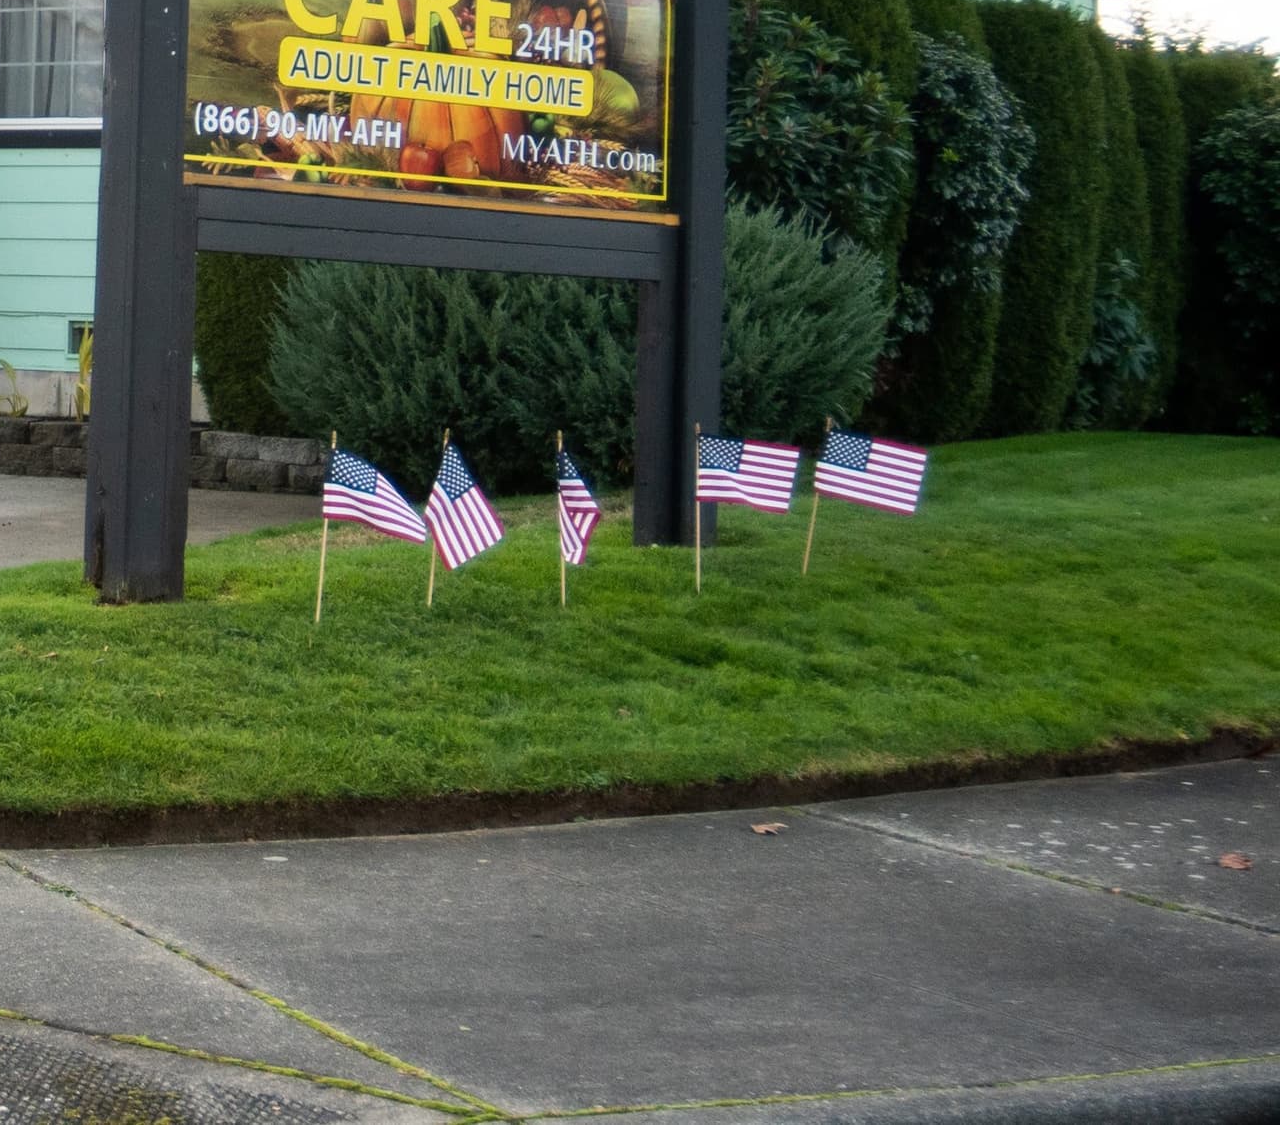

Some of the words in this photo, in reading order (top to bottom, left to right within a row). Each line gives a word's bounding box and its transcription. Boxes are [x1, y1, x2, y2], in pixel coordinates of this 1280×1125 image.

[515, 22, 595, 65] 24HR
[289, 48, 390, 87] ADULT
[397, 59, 497, 99] FAMILY
[505, 72, 585, 108] HOME
[194, 101, 259, 140] (866)
[265, 109, 402, 149] 90-MY-AFH
[502, 132, 657, 173] MYAFH.com
